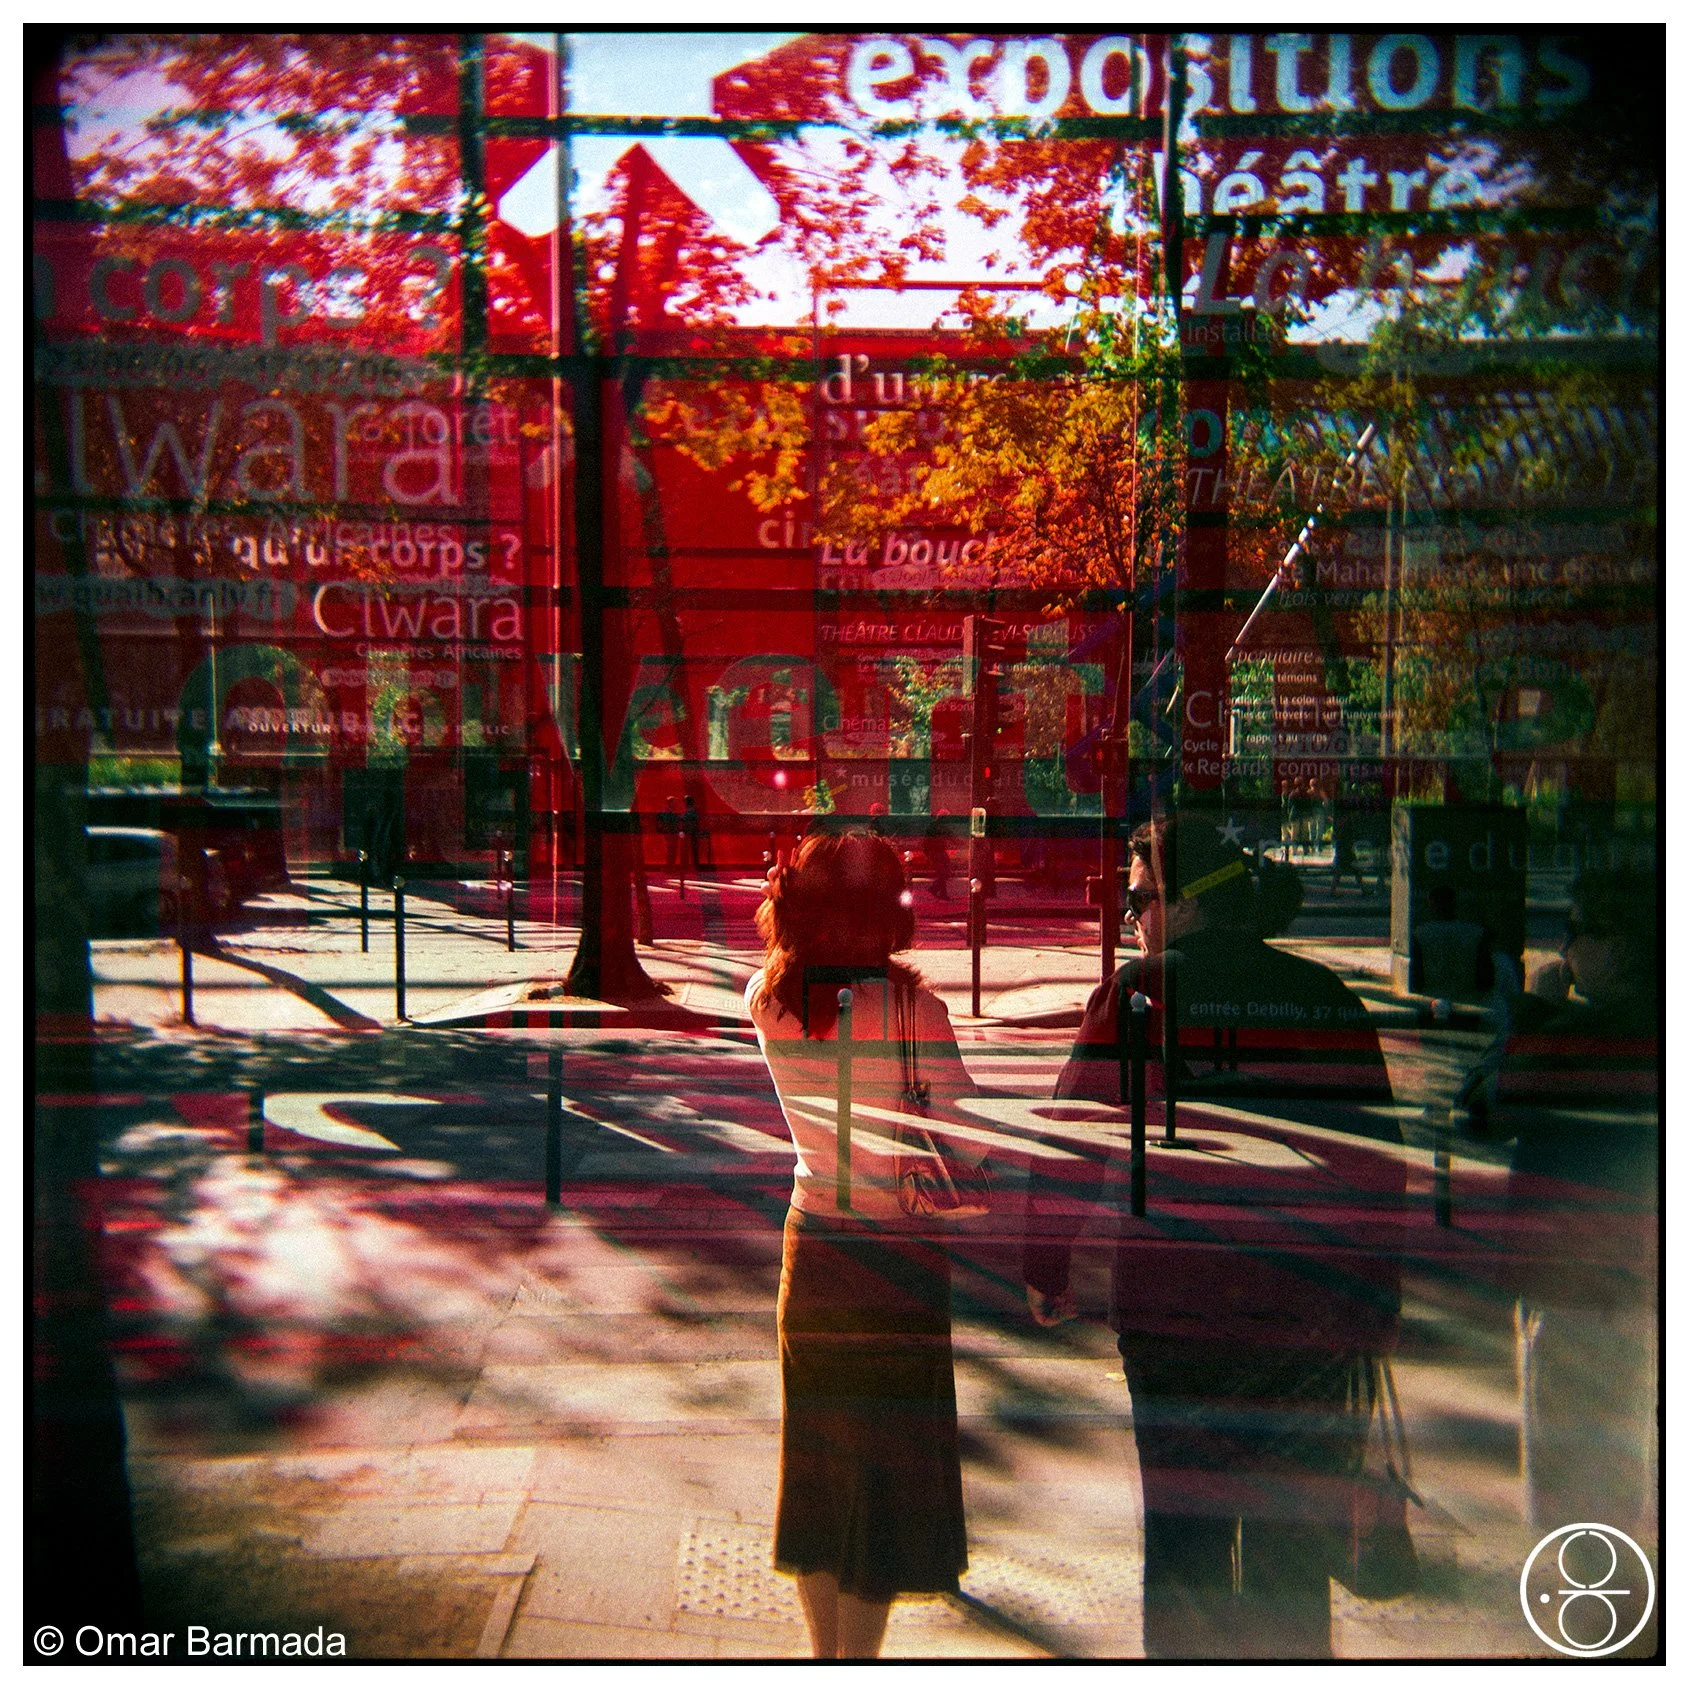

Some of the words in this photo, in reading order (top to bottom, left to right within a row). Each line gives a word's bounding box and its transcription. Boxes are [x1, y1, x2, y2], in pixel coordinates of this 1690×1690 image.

[846, 33, 1592, 119] expositions
[369, 533, 487, 575] corps
[498, 534, 523, 570] ?
[821, 619, 899, 642] THÉÂTRE
[903, 619, 970, 642] CLAUD
[1277, 672, 1318, 683] témoins
[1183, 738, 1218, 752] Cycle
[851, 764, 929, 788] musée
[1197, 759, 1271, 781] Regards
[1189, 1001, 1242, 1017] entrée
